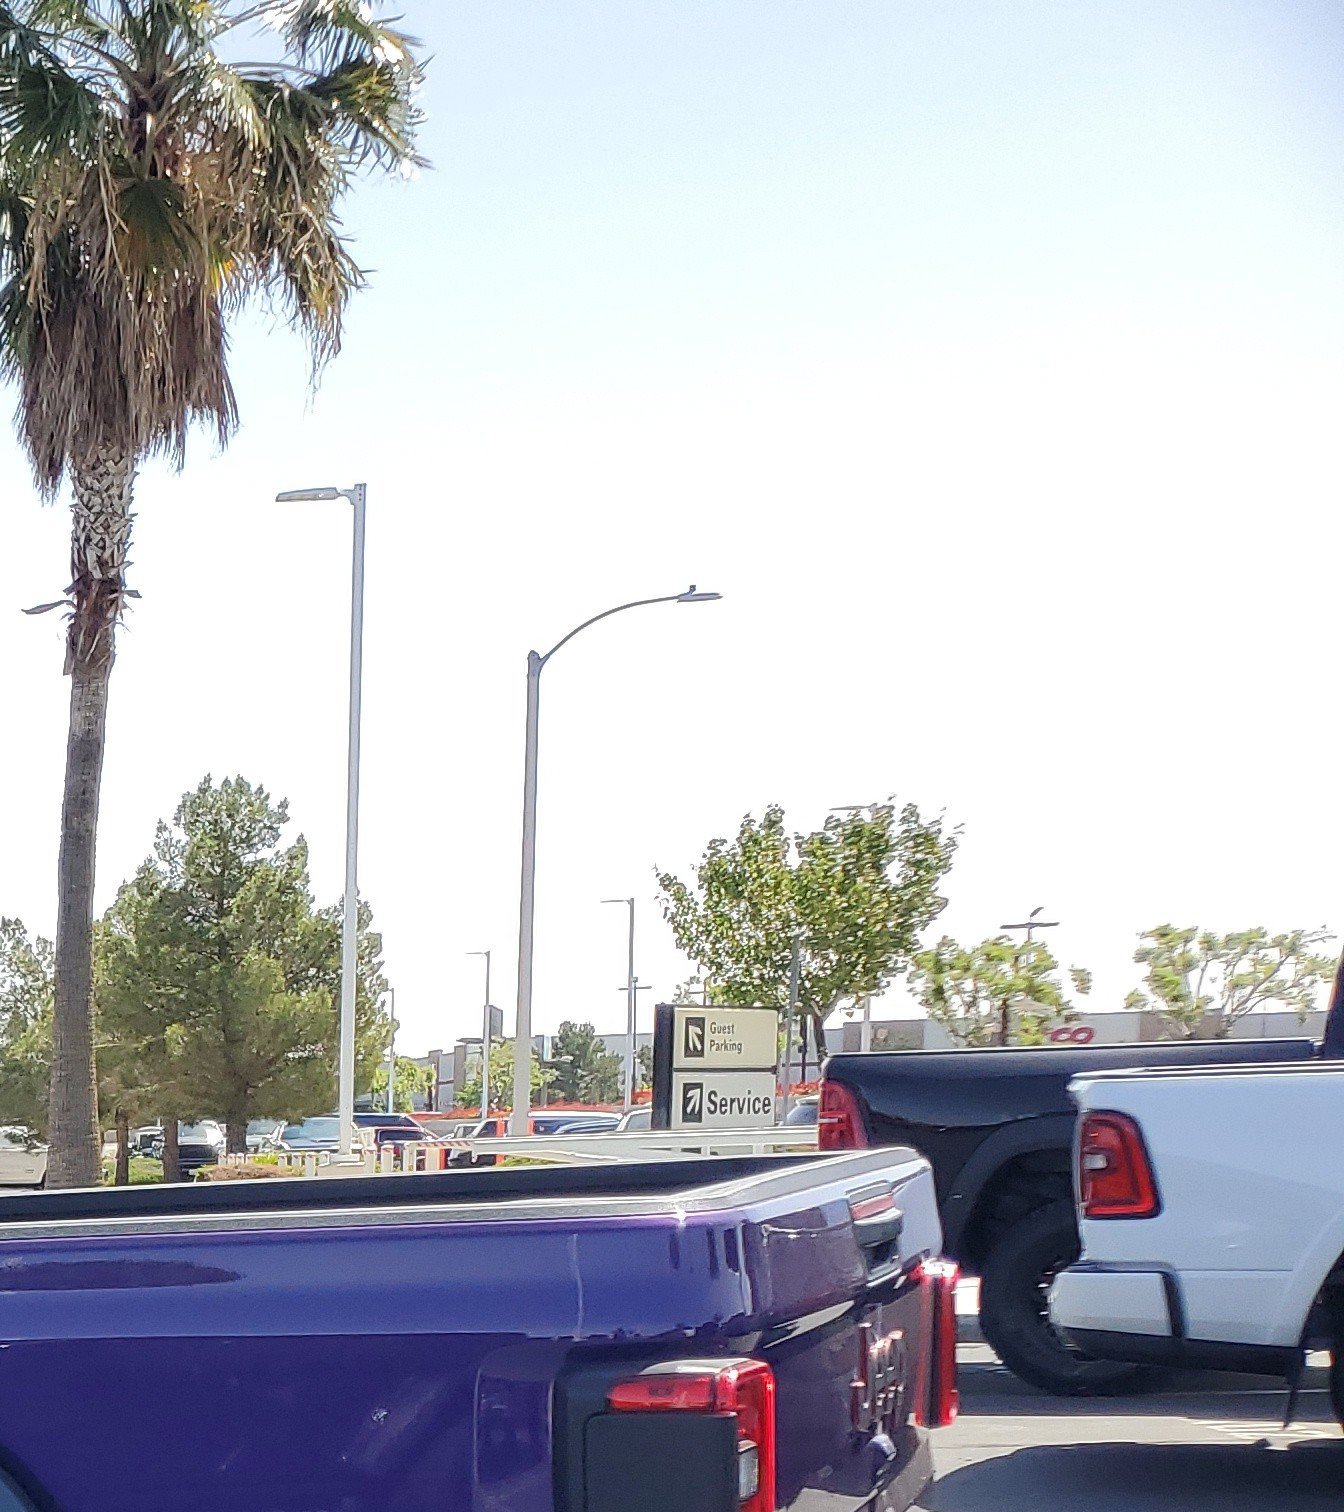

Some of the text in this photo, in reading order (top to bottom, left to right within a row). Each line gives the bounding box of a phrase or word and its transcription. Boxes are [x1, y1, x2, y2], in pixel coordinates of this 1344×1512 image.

[709, 1021, 735, 1035] Guest
[709, 1039, 743, 1055] Parking
[706, 1089, 772, 1116] Service
